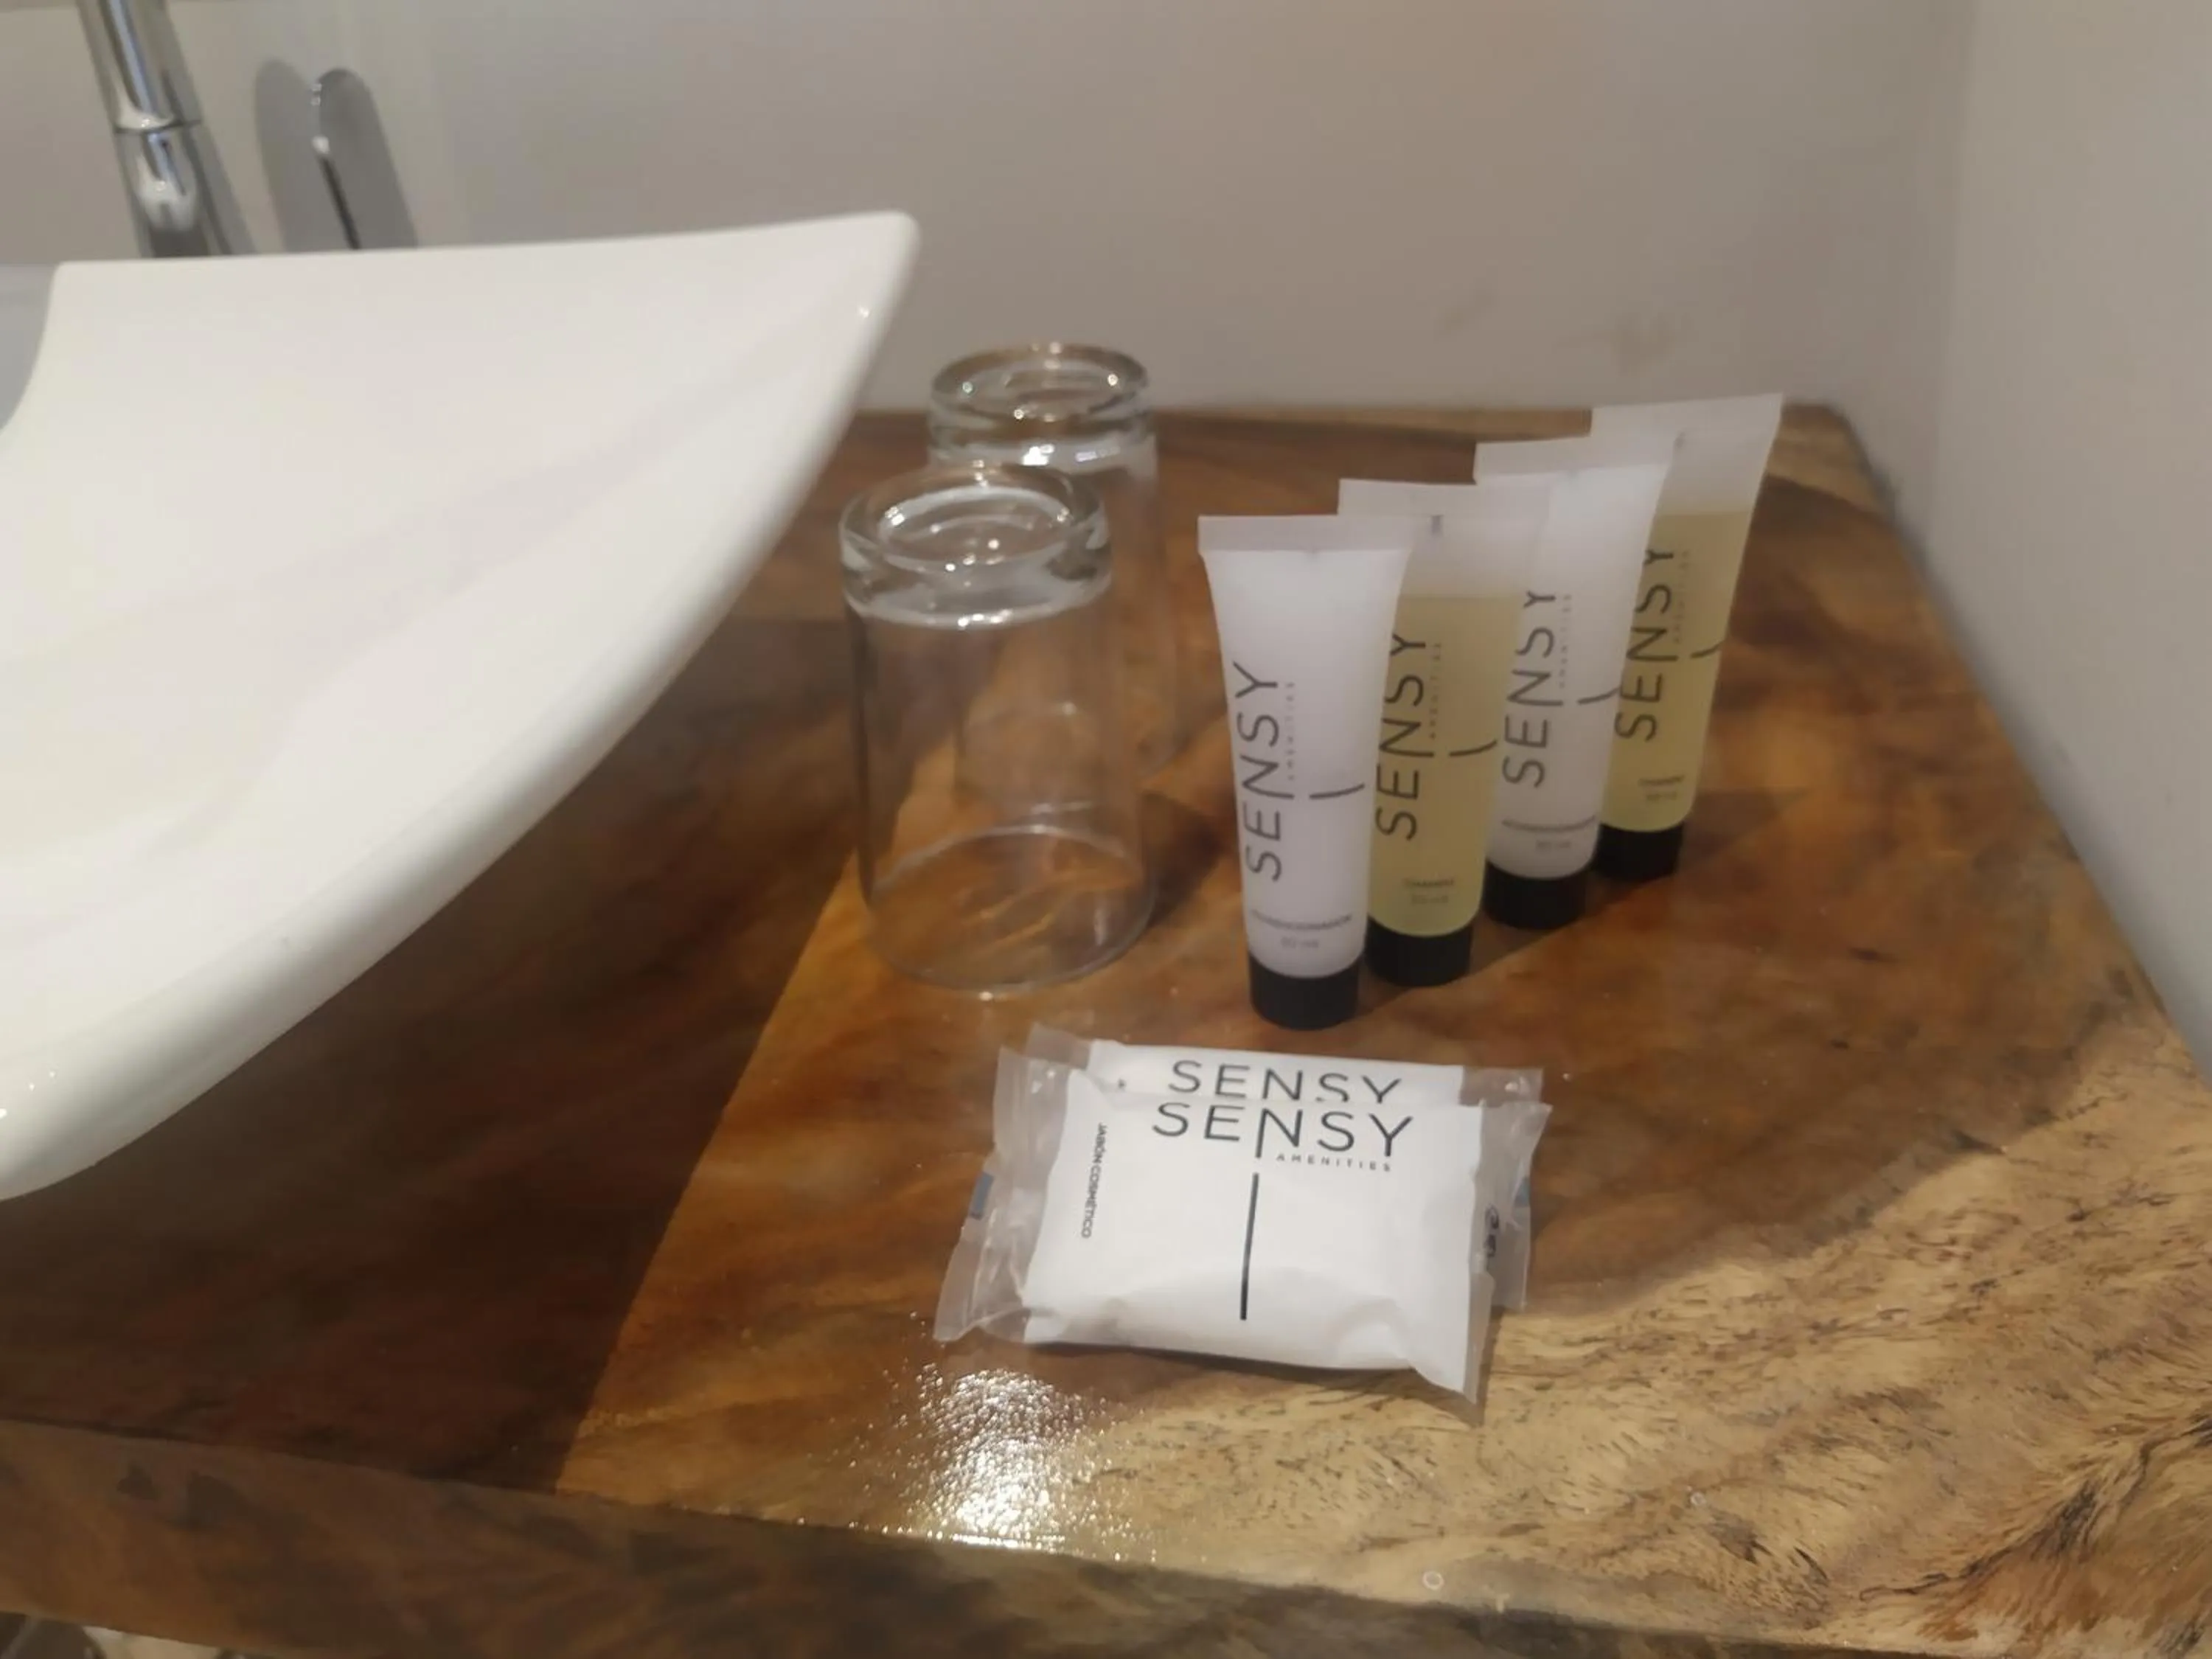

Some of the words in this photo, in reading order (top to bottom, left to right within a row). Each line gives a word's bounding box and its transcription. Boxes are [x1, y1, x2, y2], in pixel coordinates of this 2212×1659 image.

[1375, 633, 1434, 841] SENSY
[1502, 591, 1563, 787] SENSY
[1615, 549, 1678, 742] SENSY
[1233, 661, 1294, 882] SENSY
[1152, 1102, 1413, 1158] SENSY
[1169, 1060, 1402, 1103] SENSY
[1276, 1153, 1391, 1172] AMENITIES
